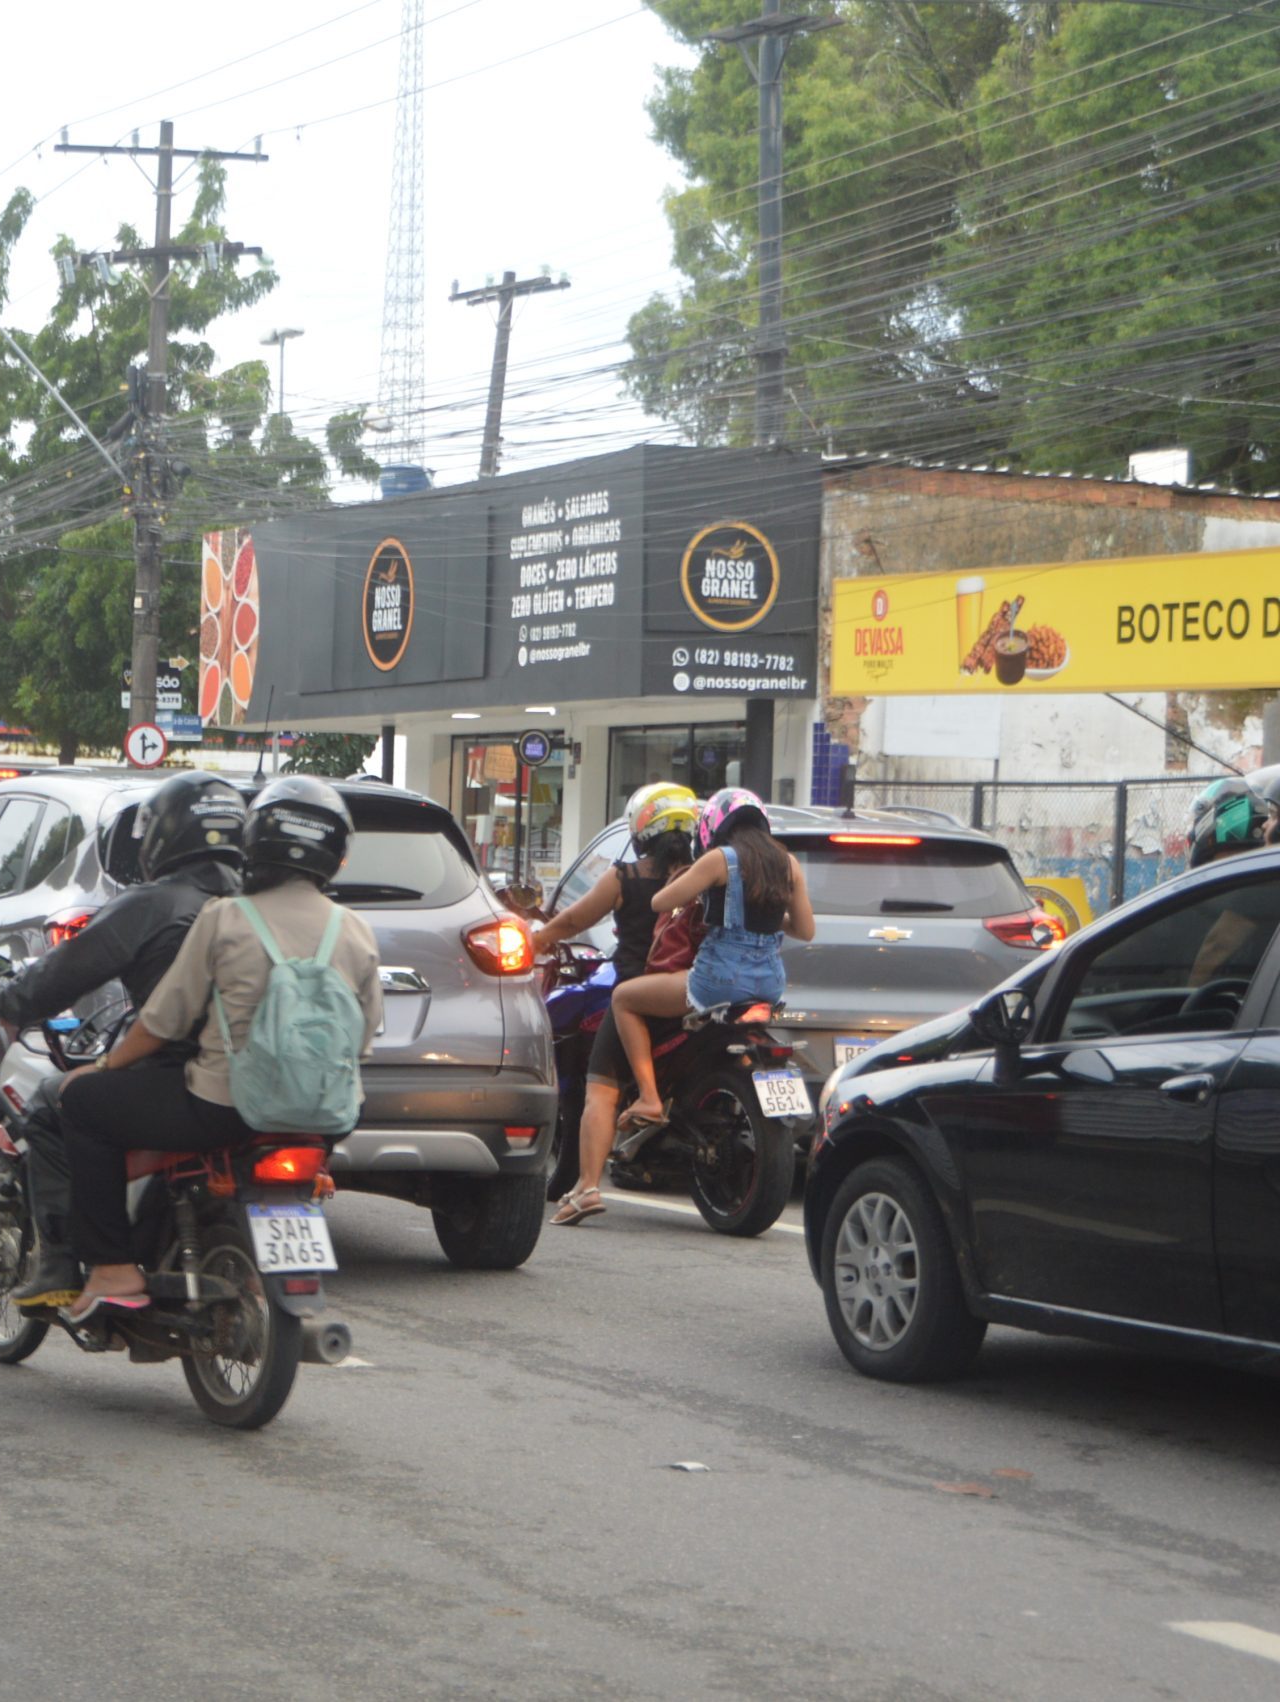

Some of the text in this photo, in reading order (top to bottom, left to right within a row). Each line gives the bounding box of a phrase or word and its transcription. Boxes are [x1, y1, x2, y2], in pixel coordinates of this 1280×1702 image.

[565, 490, 608, 521] SALGADOS
[510, 530, 562, 559] SUPLEMENTOS
[520, 550, 617, 588] DOCES ZERO LÁCTEOS
[705, 559, 755, 580] NOSSO
[375, 584, 402, 608] NOSSO
[511, 582, 614, 618] ZERO GLÚTEN TEMPERO
[701, 578, 758, 599] GRANEL
[372, 608, 402, 632] GRANEL
[1117, 597, 1280, 644] BOTECO D
[855, 626, 904, 656] DEVASSA
[694, 648, 794, 671] (82) 98193-7782
[693, 676, 807, 691] @nossogranelbr
[766, 1080, 796, 1096] RGS
[269, 1219, 313, 1241] SAH
[265, 1242, 326, 1265] 3A65
